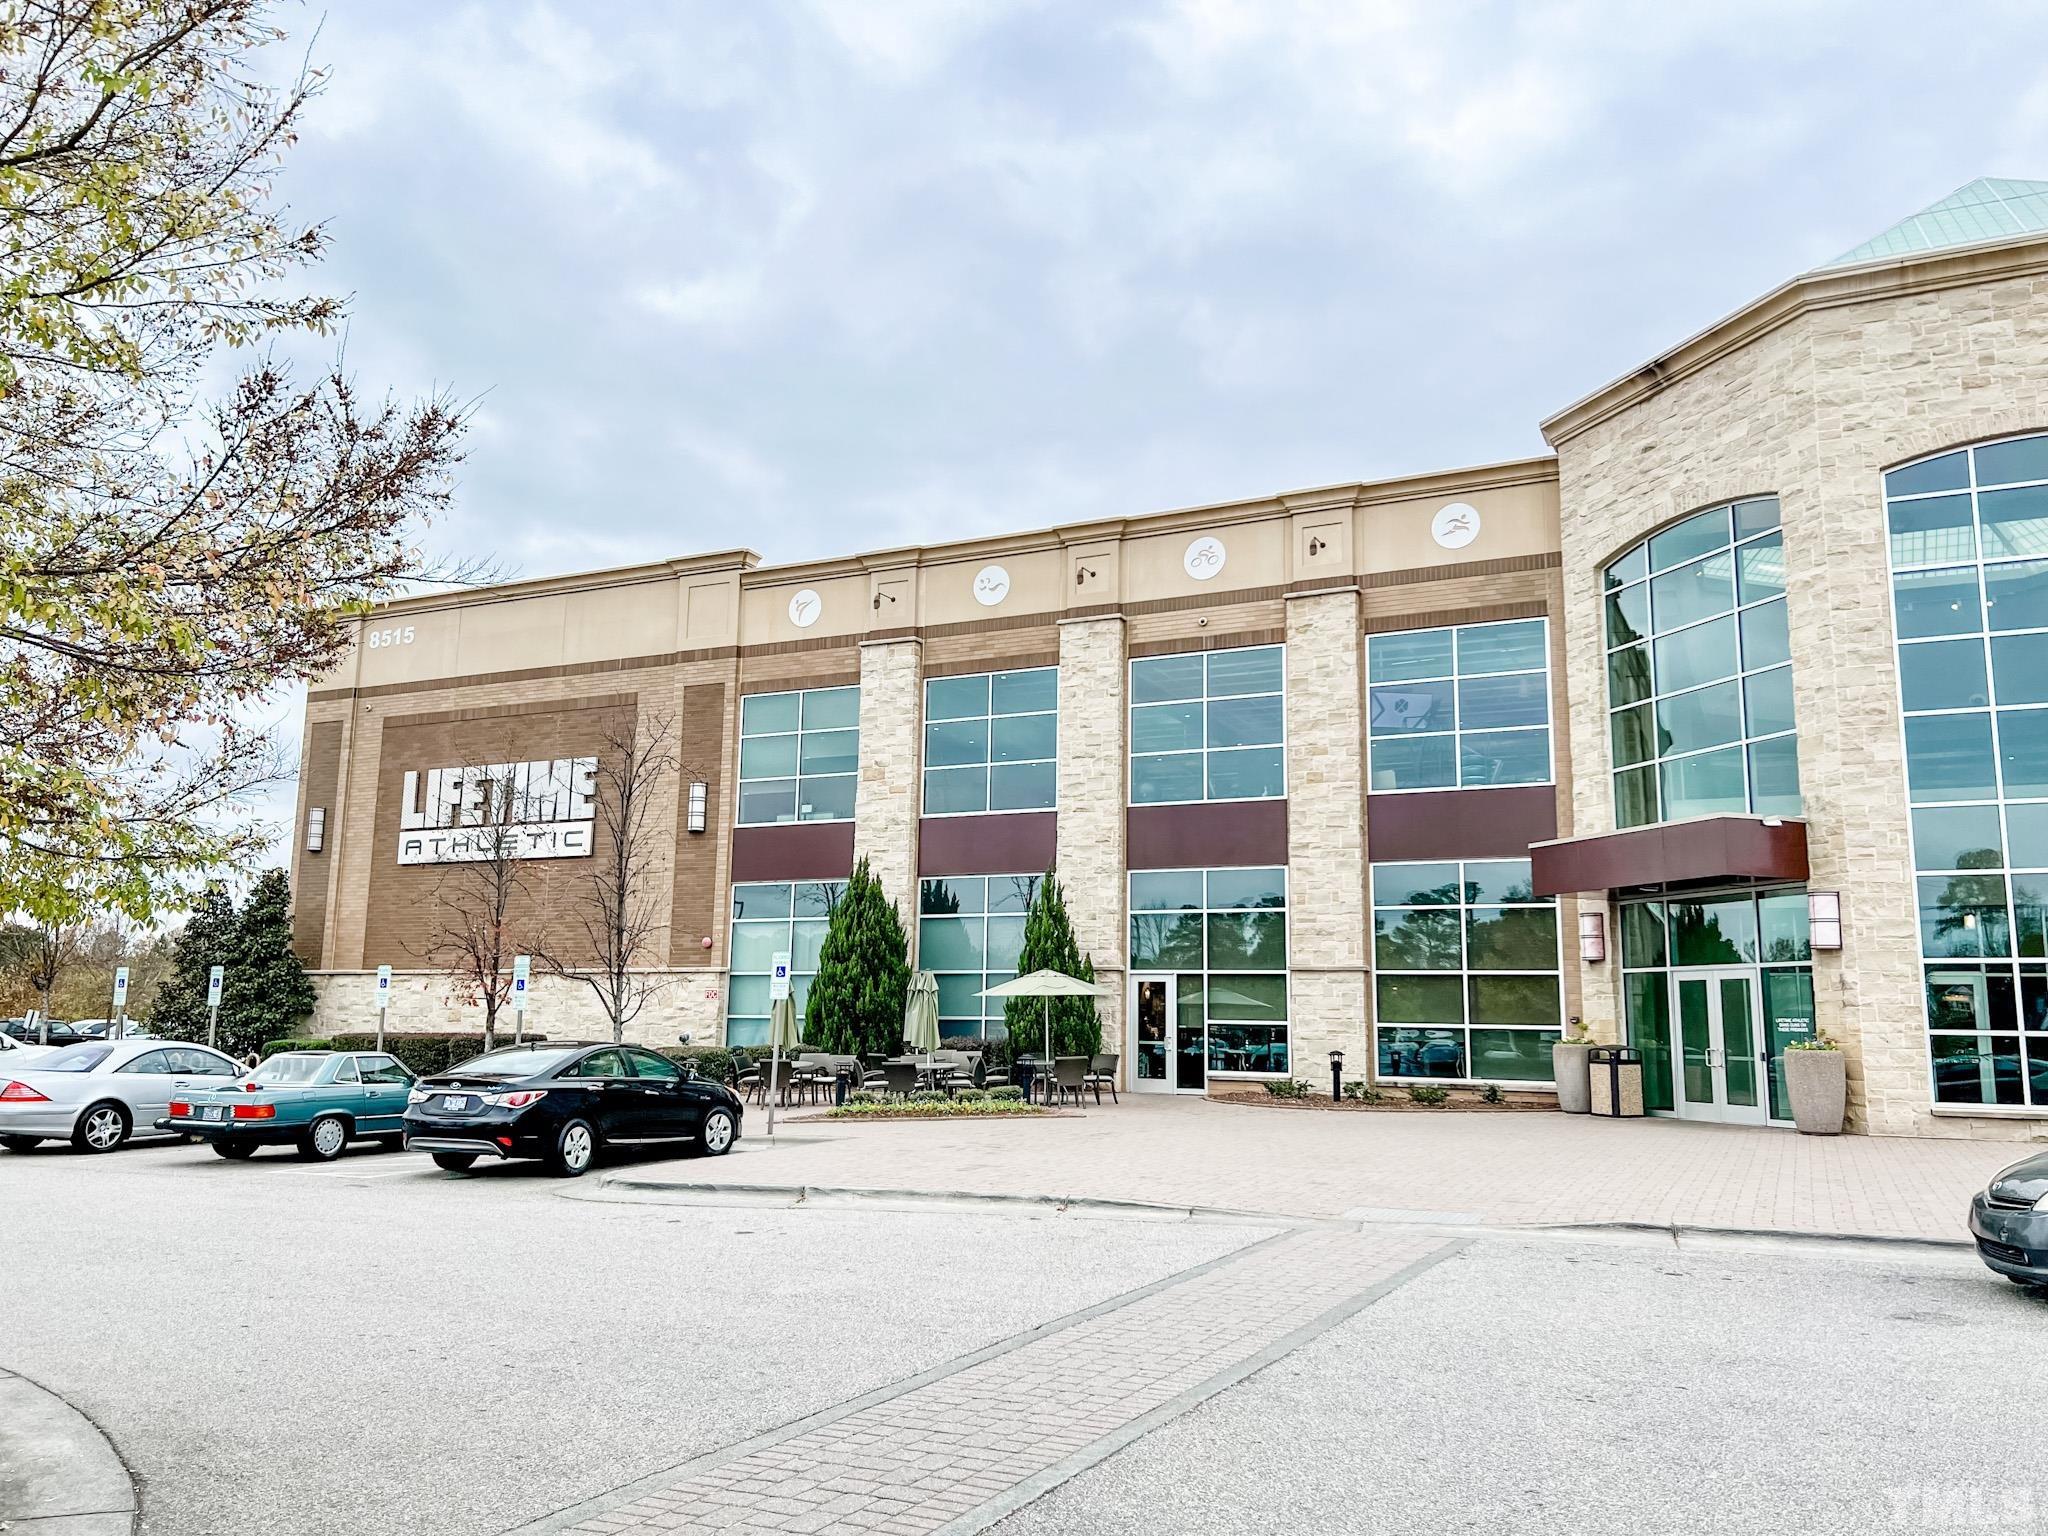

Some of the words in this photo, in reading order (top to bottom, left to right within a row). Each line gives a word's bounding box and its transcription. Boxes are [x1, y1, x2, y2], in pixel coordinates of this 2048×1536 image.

[369, 626, 415, 649] 8515
[400, 756, 599, 830] LIFETIME
[404, 830, 584, 855] ATHLETIC
